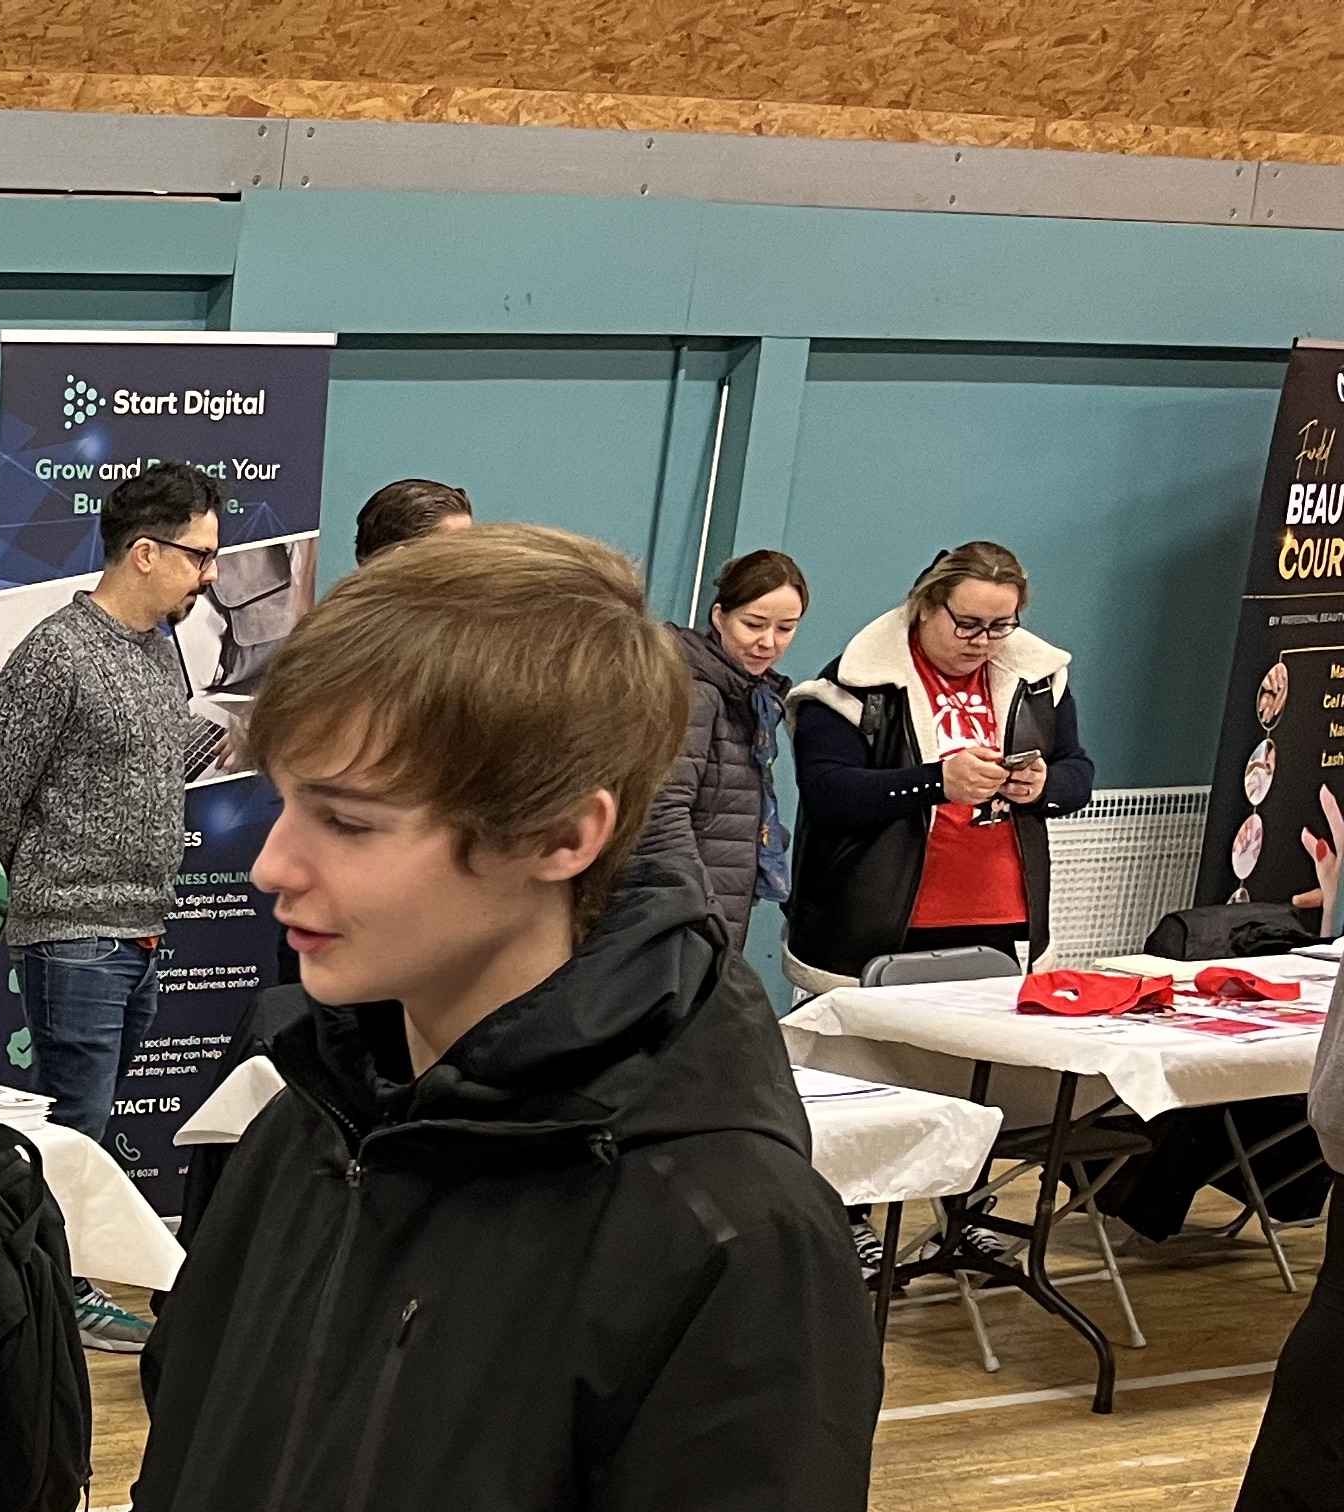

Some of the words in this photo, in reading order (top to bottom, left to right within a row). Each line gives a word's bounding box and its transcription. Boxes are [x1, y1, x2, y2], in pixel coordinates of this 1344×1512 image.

[113, 389, 177, 415] Start
[184, 389, 265, 421] Digital
[35, 459, 94, 480] Grow
[99, 457, 141, 480] and
[232, 458, 281, 480] Your
[185, 893, 215, 907] digital
[216, 893, 248, 904] culture
[218, 907, 257, 919] systems.
[189, 967, 214, 978] steps
[215, 966, 225, 975] to
[227, 965, 257, 975] secure
[165, 982, 186, 993] your
[187, 979, 226, 991] business
[227, 977, 259, 988] online?
[144, 1037, 171, 1048] social
[172, 1036, 201, 1047] media
[149, 1054, 160, 1062] so
[161, 1051, 182, 1064] they
[183, 1051, 201, 1060] can
[202, 1049, 222, 1060] help
[145, 1065, 165, 1077] stay
[166, 1065, 199, 1076] secure.
[159, 1097, 181, 1112] US
